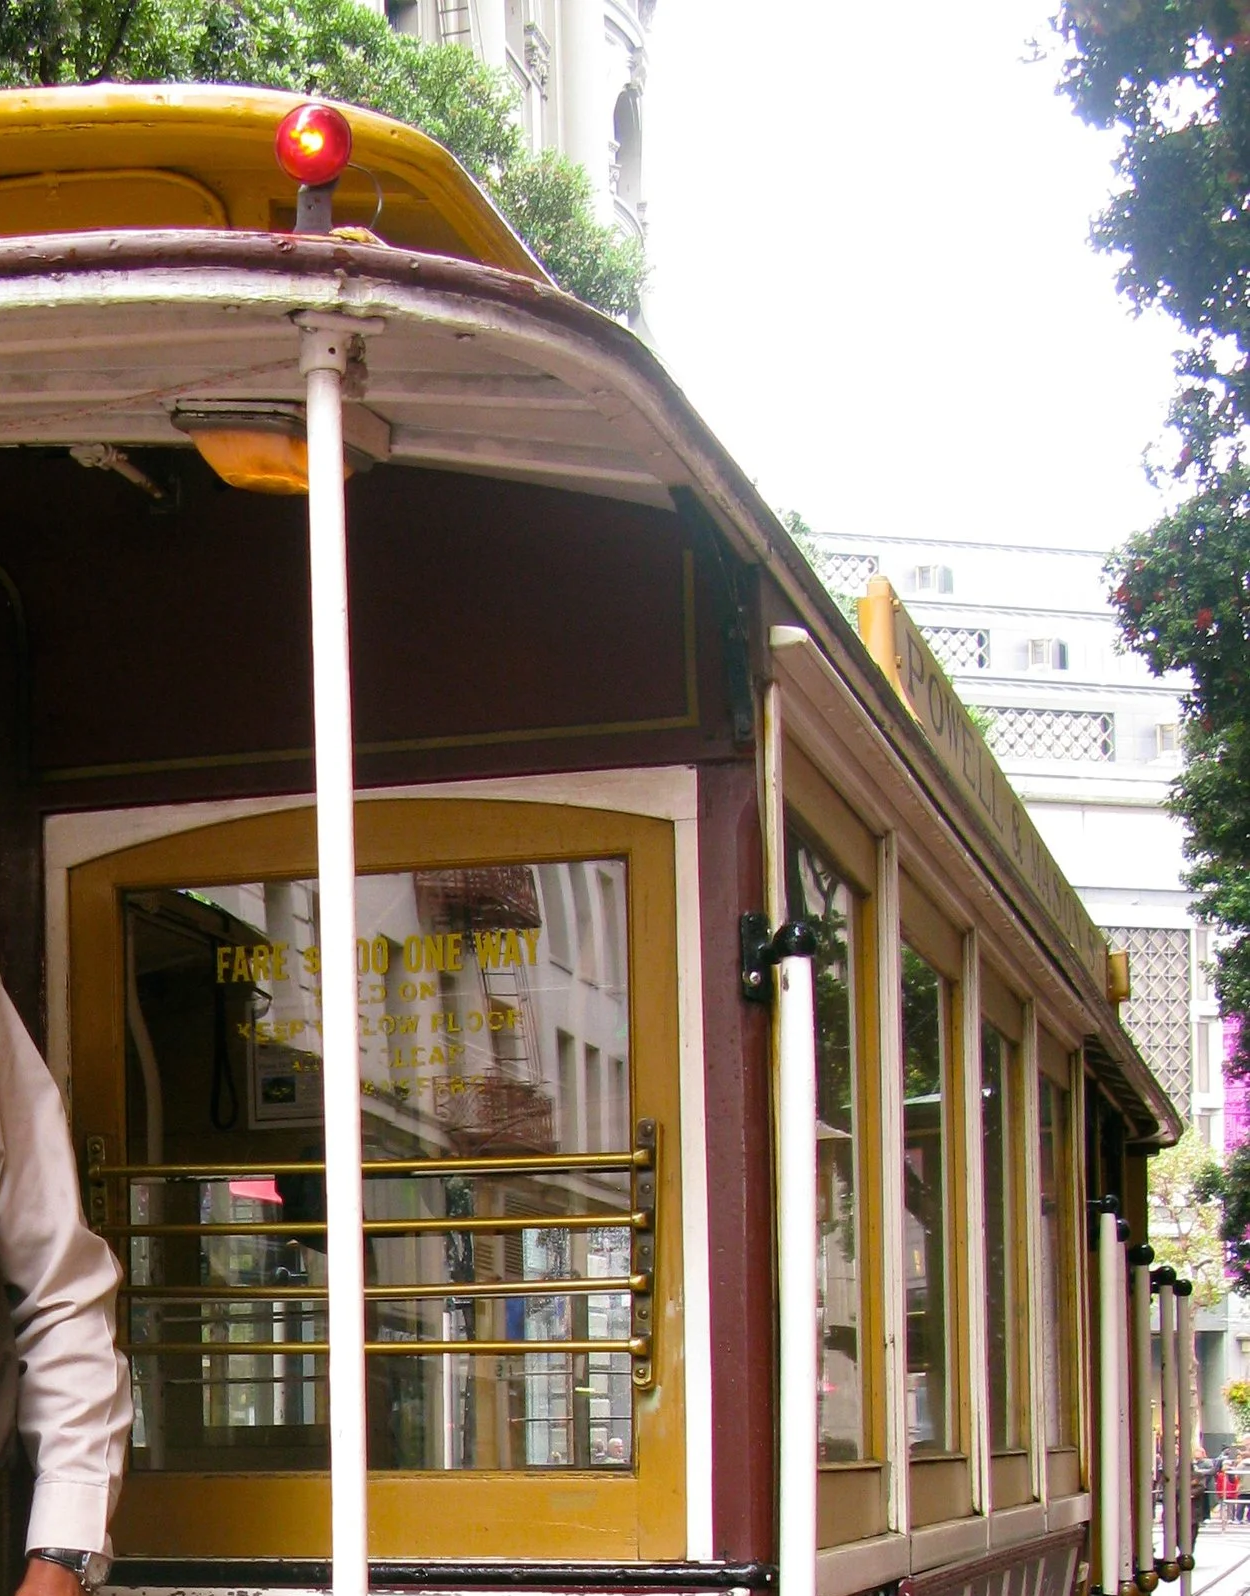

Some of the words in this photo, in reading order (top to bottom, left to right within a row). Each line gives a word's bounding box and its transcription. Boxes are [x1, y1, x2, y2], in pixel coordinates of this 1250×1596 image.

[906, 628, 1003, 833] POWELL
[217, 941, 290, 984] FARE
[402, 933, 463, 974] ONE
[474, 928, 541, 970] WAY
[398, 980, 437, 1003] ON
